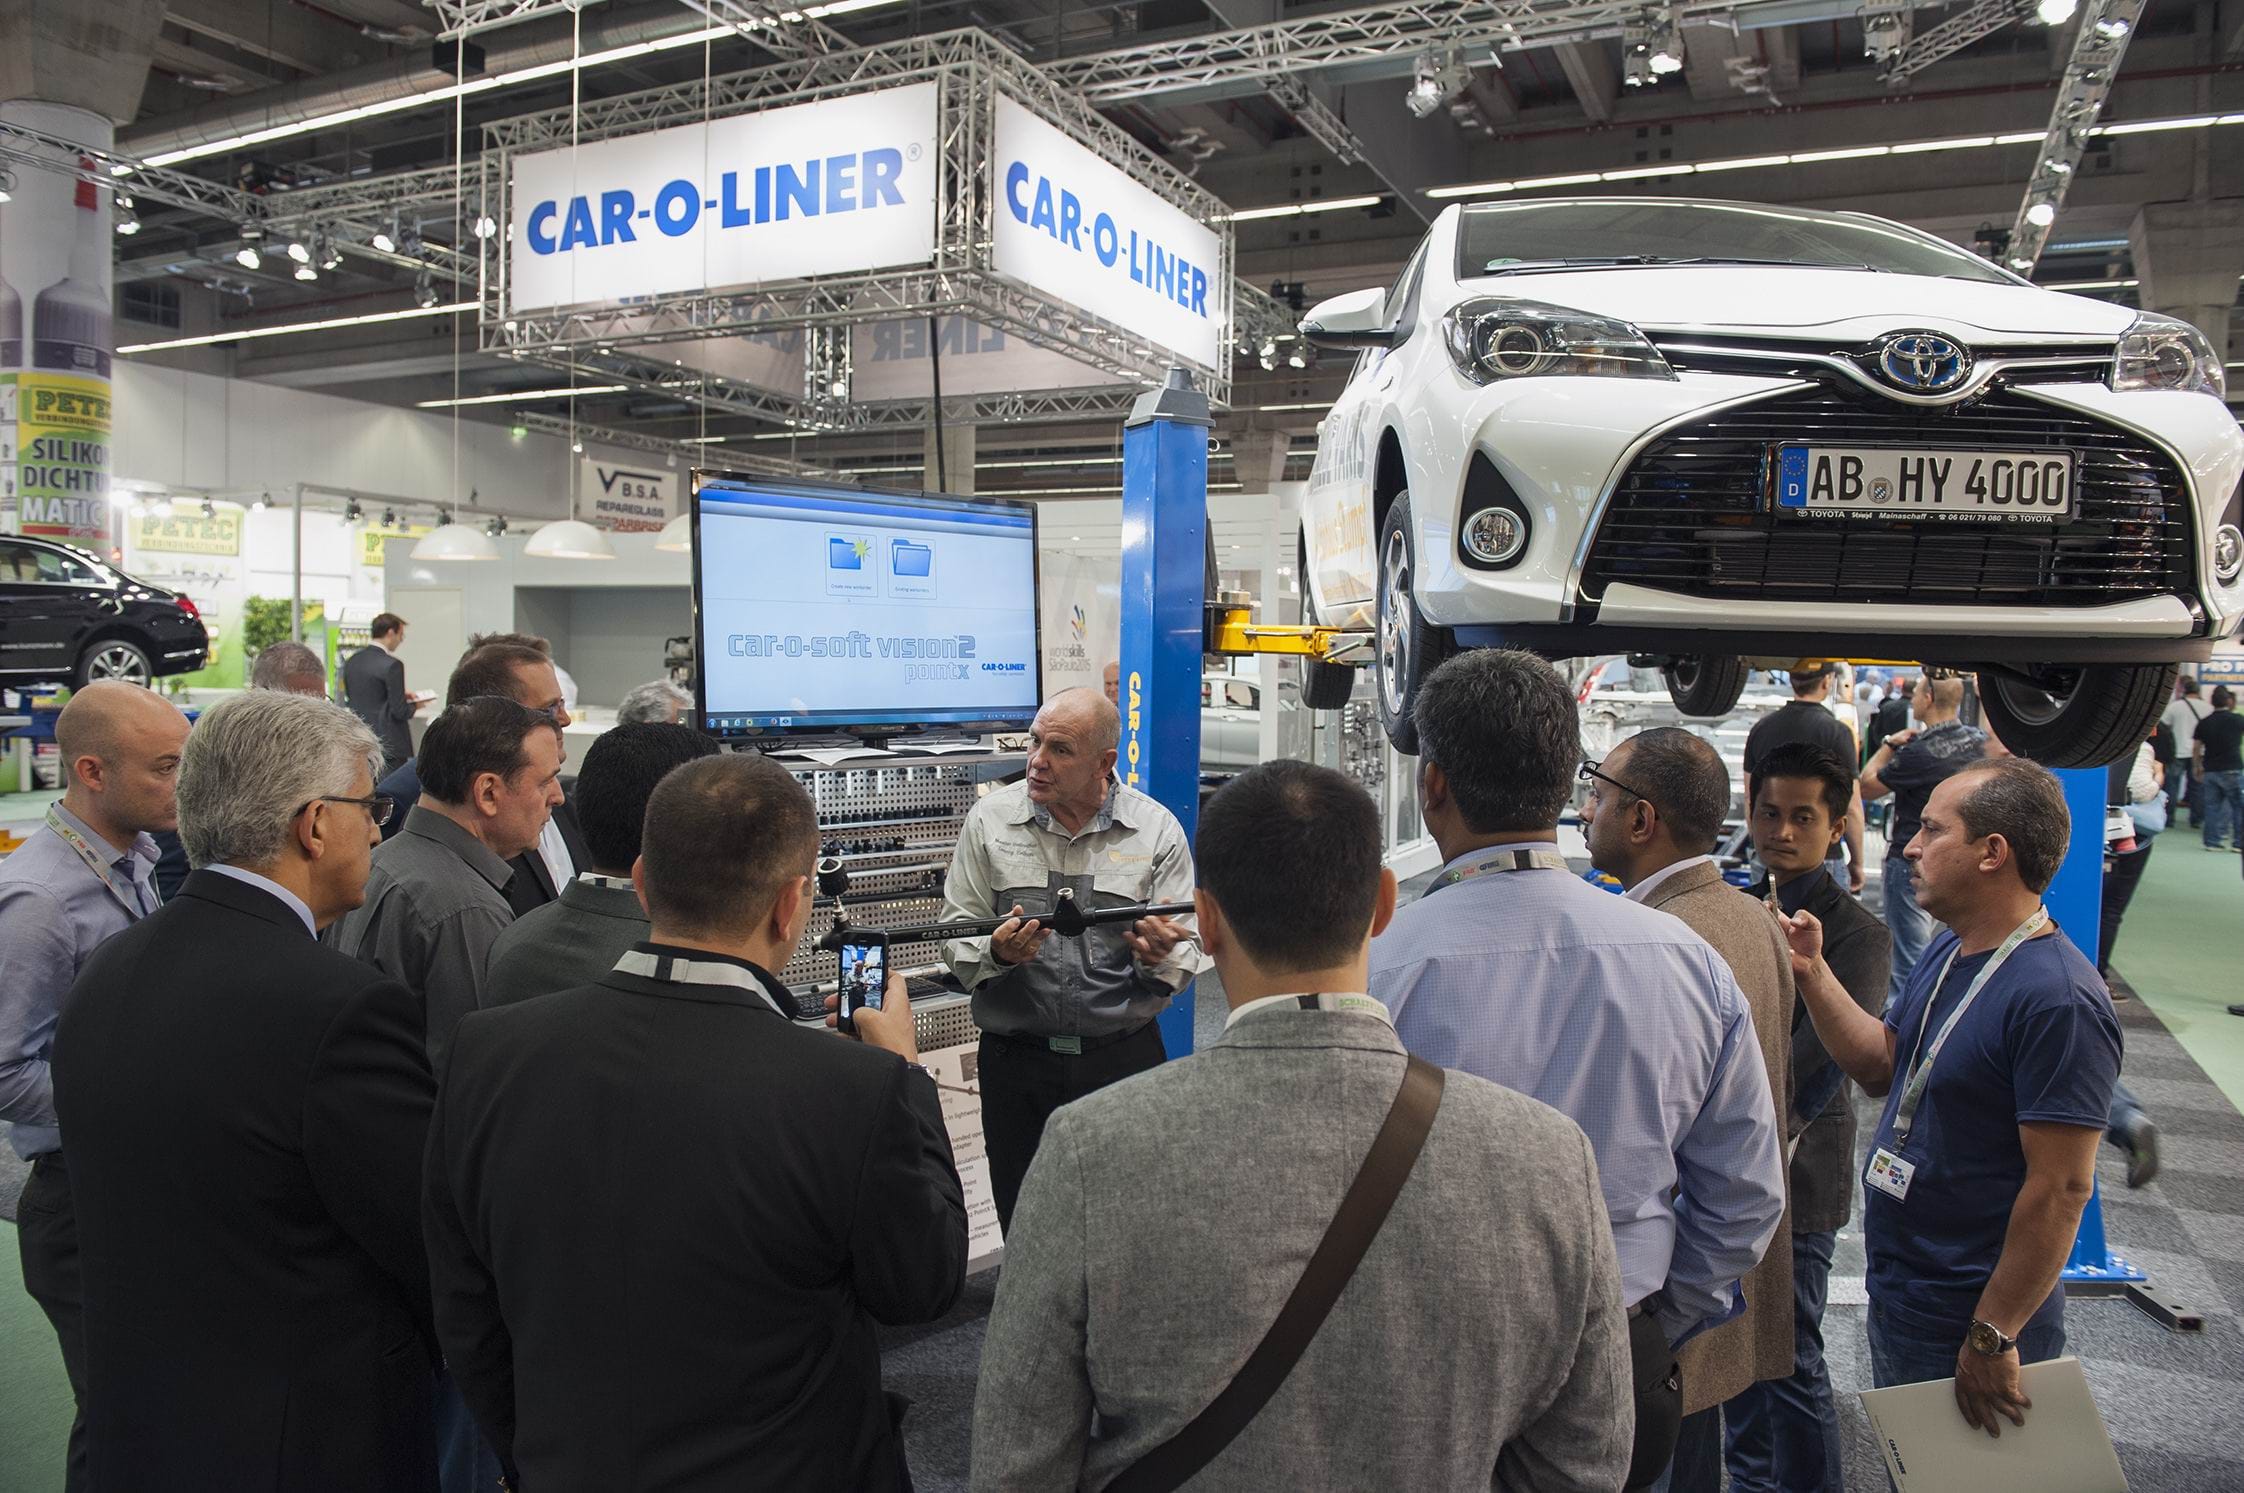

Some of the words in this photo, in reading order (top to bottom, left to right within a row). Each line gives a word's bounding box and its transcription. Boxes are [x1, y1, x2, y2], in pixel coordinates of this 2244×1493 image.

[527, 147, 906, 256] CAR-O-LINER
[1006, 160, 1208, 319] CAR-O-LINER
[36, 390, 111, 420] PETE
[1789, 484, 1799, 496] D
[1811, 455, 1865, 500] AB
[1899, 457, 1952, 503] HY
[1965, 459, 2065, 506] 4000
[1810, 510, 1845, 518] TOYOTA
[1878, 512, 1927, 520] Mainaschaff
[727, 631, 872, 658] car-o-soft
[981, 663, 1026, 671] CAR-O-LINER
[1127, 671, 1142, 789] CAR-O-L
[921, 927, 979, 940] CAR-O-LINER
